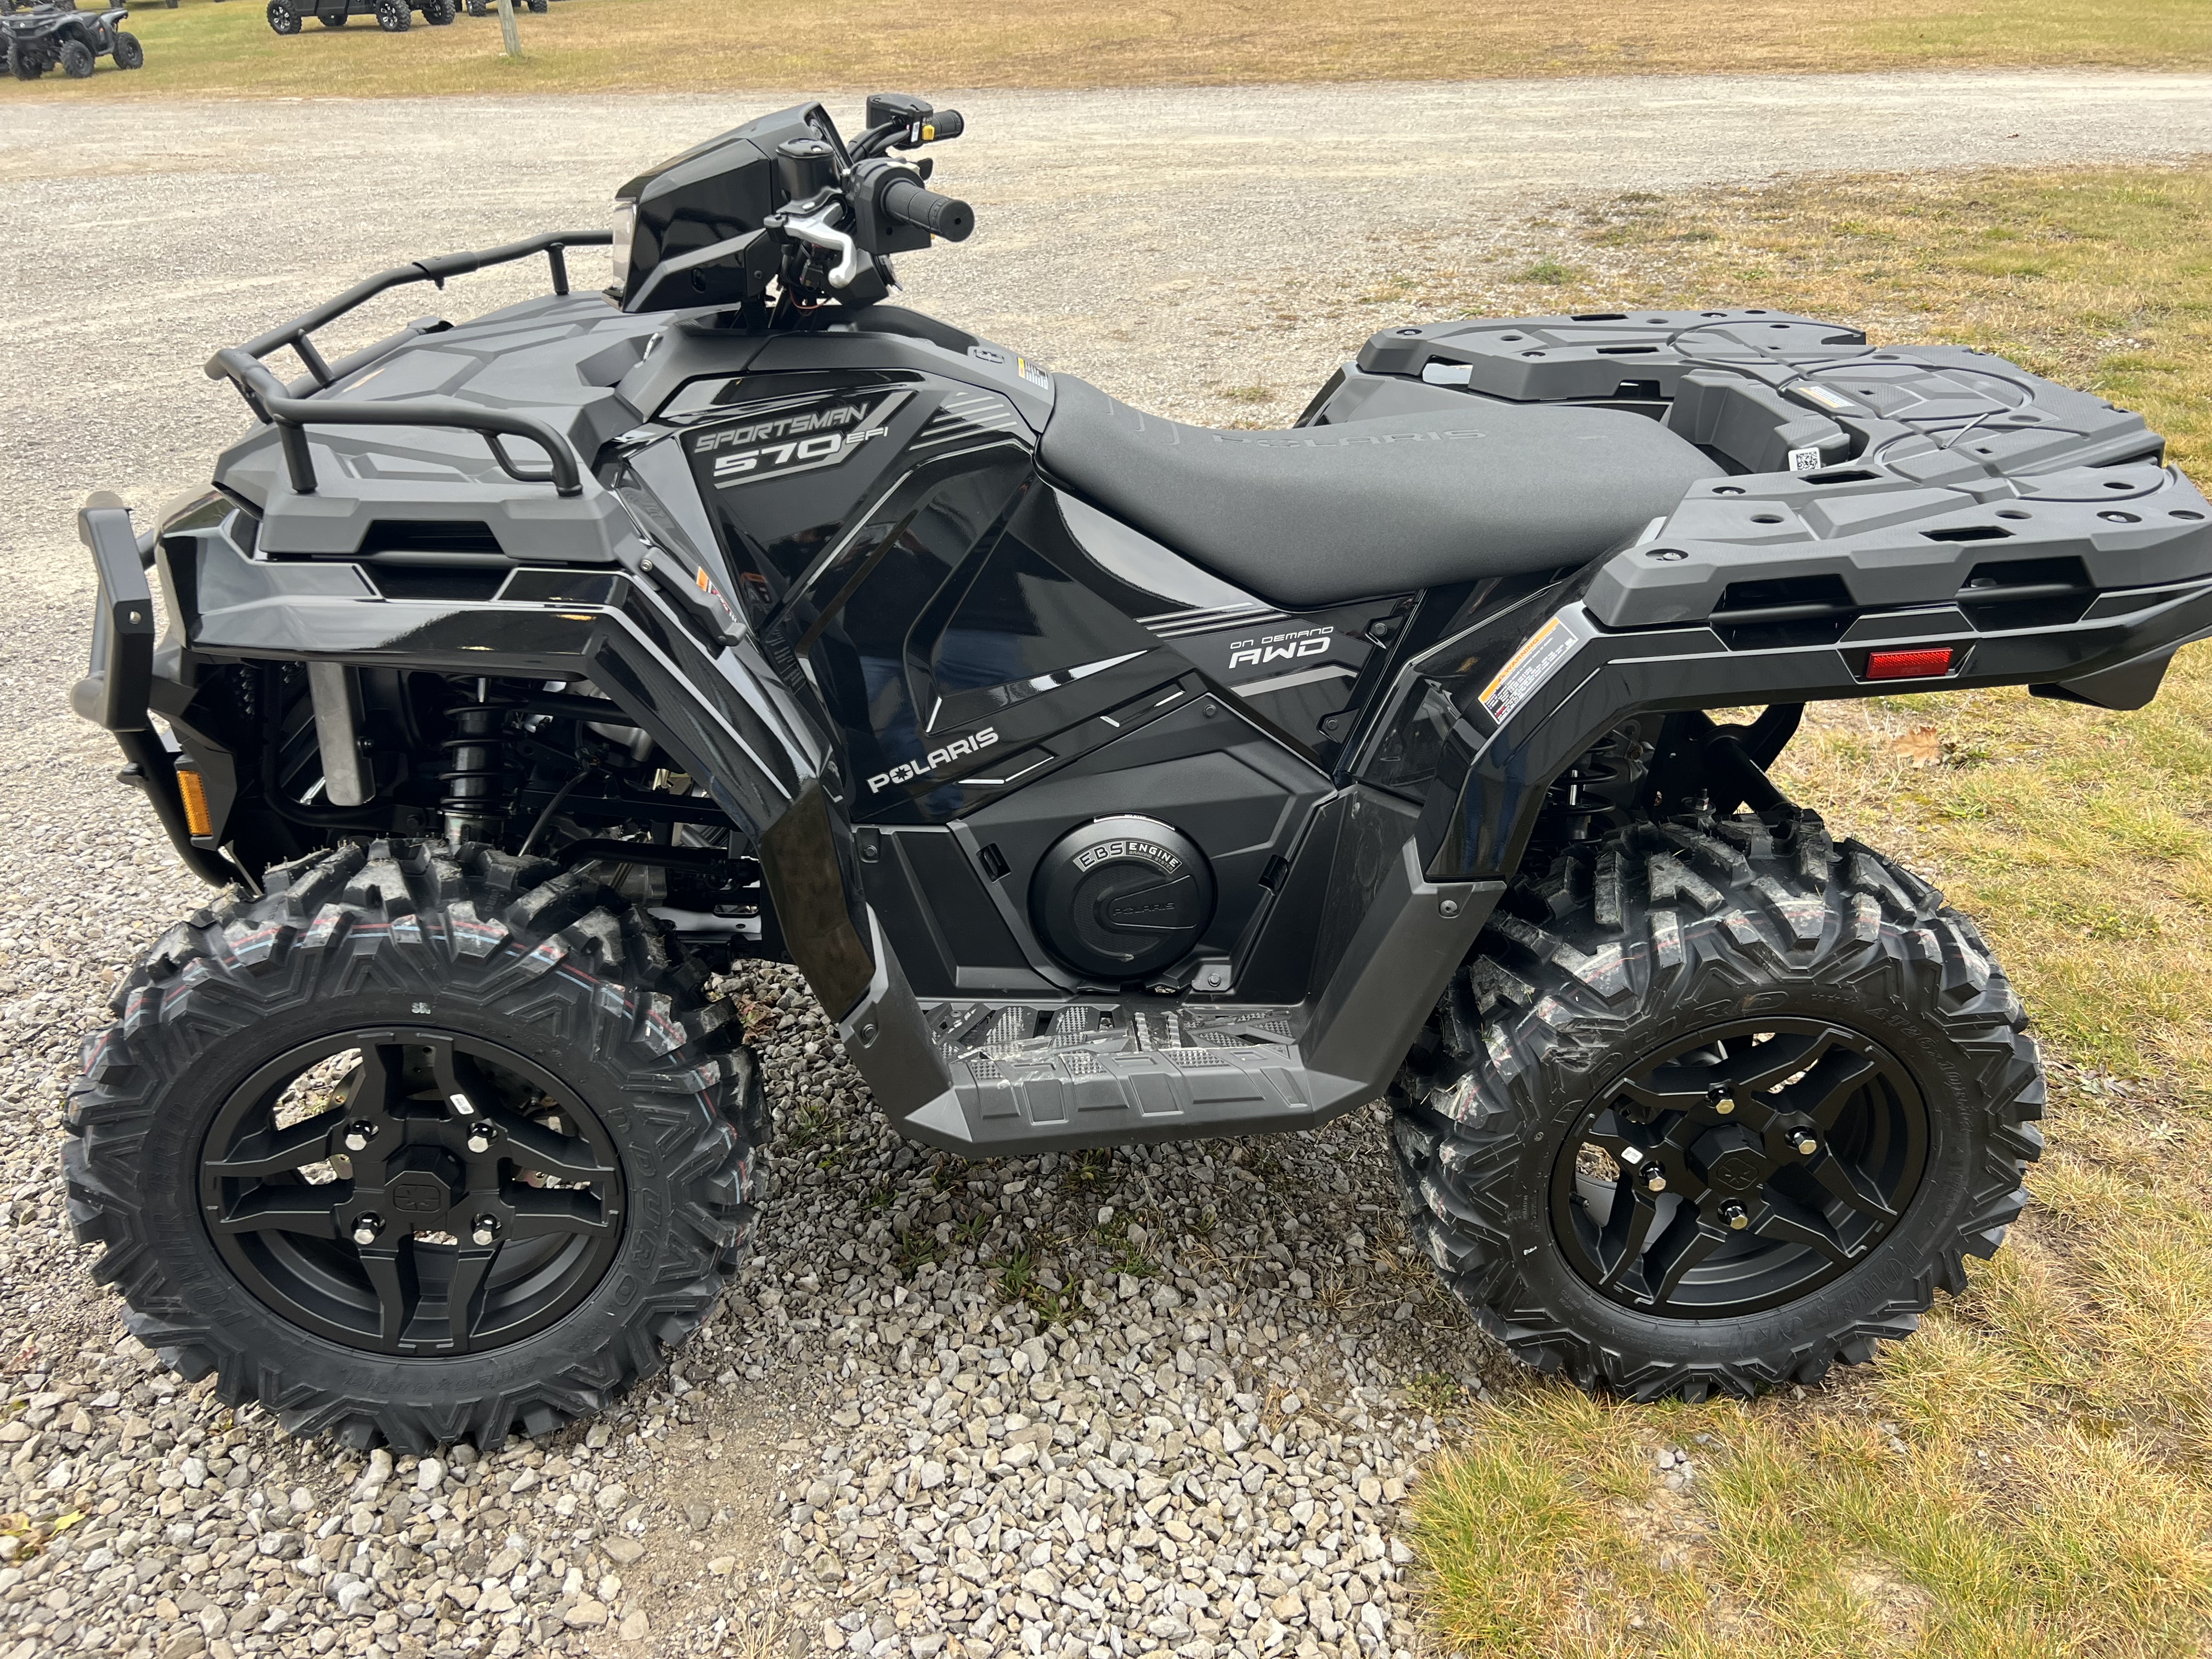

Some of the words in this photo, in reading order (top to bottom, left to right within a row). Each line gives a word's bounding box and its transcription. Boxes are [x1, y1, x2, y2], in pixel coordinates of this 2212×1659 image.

[694, 402, 870, 454] SPORTSMAN
[1212, 428, 1488, 449] POLARIS
[713, 433, 842, 477] 570
[845, 426, 889, 445] EFI
[1228, 636, 1331, 669] AWD
[1230, 640, 1254, 650] ON
[1261, 626, 1334, 644] DEMAND
[1504, 638, 1540, 674] WARNING
[866, 726, 1000, 794] POLARIS
[1078, 842, 1125, 868] EBS
[1128, 842, 1180, 868] ENGINE
[1128, 850, 1153, 859] BRAKING
[1154, 856, 1173, 871] SYSTEM
[1113, 901, 1176, 916] POLARIS
